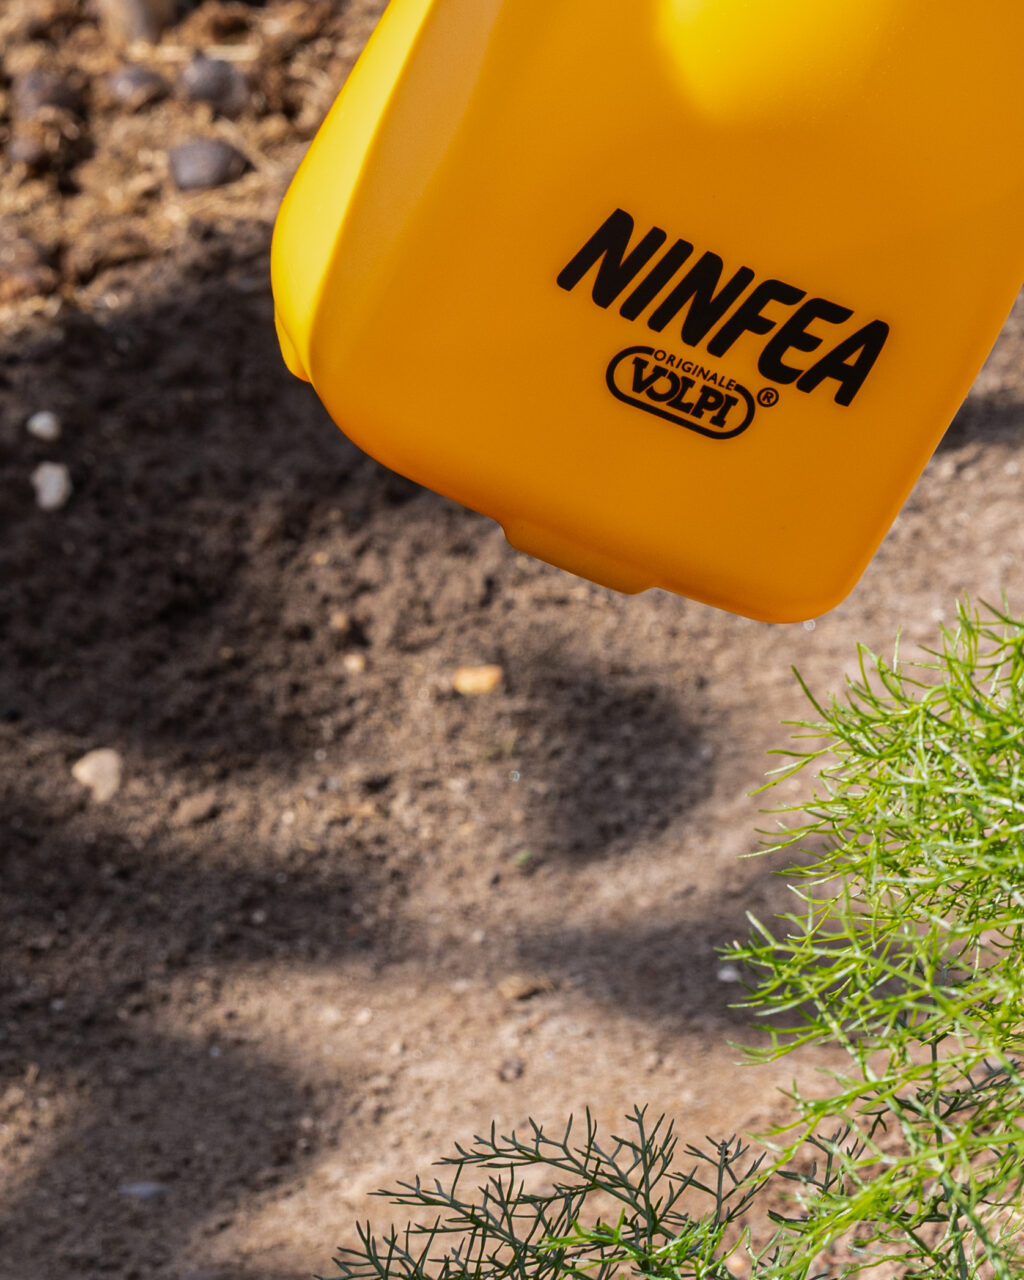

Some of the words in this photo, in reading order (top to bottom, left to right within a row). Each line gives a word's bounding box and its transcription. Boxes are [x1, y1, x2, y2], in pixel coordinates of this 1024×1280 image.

[557, 208, 889, 407] NINFEA
[631, 356, 739, 428] VOLPI
[653, 349, 737, 391] ORIGINALE
